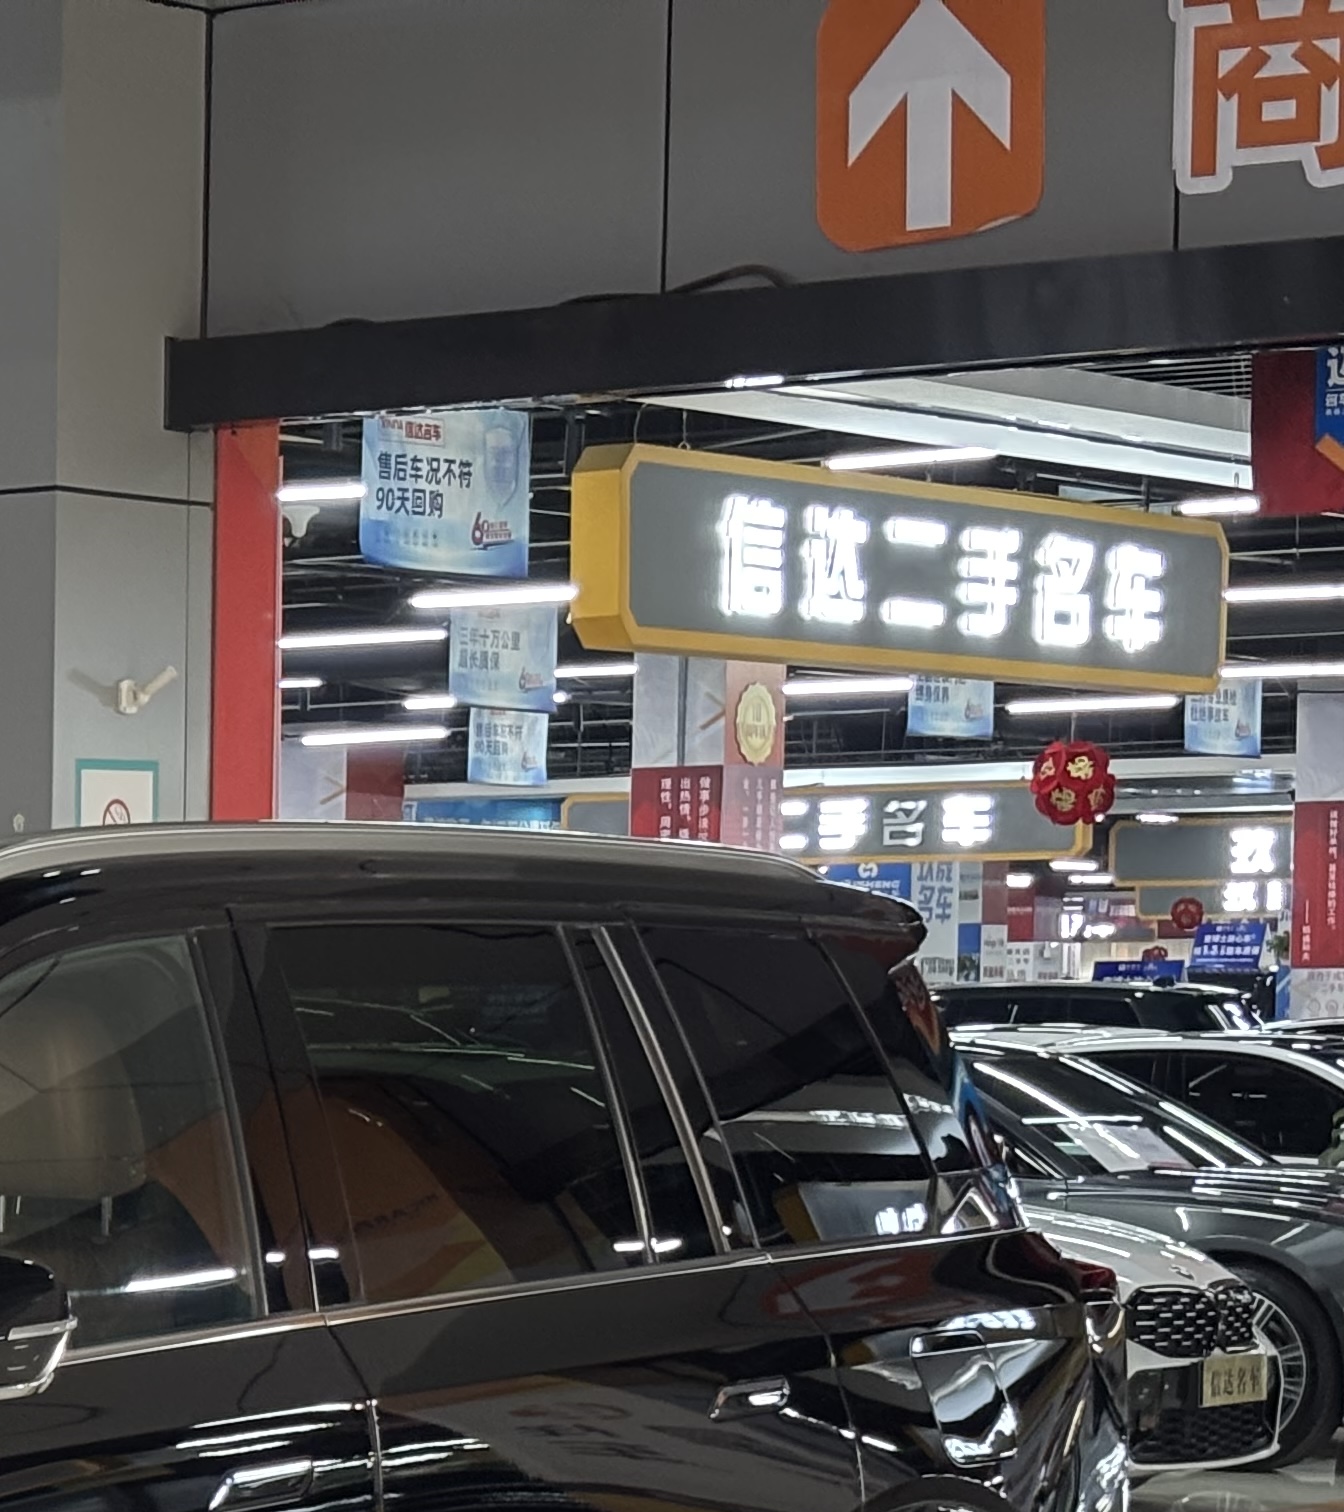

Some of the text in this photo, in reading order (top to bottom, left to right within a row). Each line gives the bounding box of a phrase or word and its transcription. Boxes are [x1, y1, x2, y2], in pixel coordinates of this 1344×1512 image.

[377, 451, 473, 489] 售后车况不符
[376, 487, 444, 519] 90天回购
[718, 496, 1165, 653] 信达二手名车
